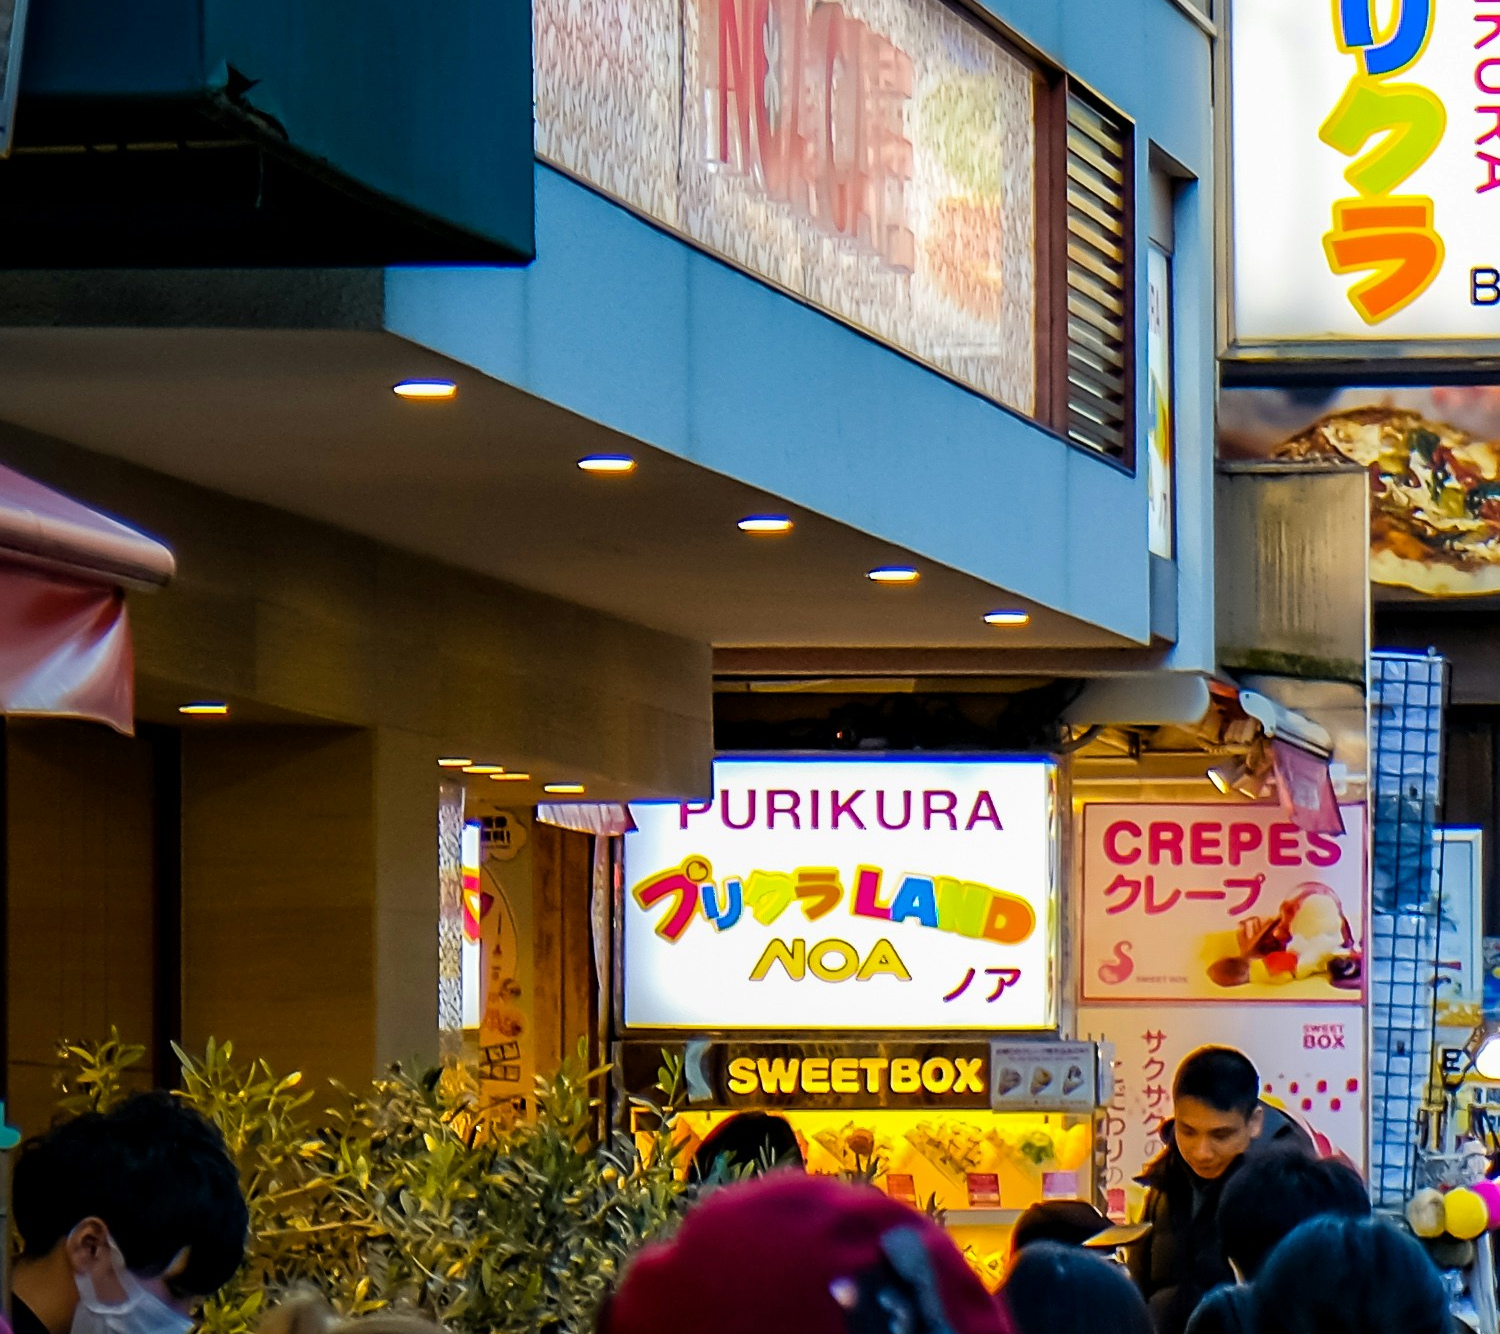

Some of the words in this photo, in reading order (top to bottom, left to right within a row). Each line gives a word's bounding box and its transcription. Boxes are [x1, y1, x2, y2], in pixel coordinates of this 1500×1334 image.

[679, 789, 1004, 831] PURIKURA
[1103, 819, 1343, 867] CREPES
[850, 863, 1036, 947] LAND
[1103, 872, 1266, 916] クレープ
[749, 937, 912, 982] NOA
[942, 967, 1021, 1003] ノア
[1302, 1034, 1346, 1049] BOX
